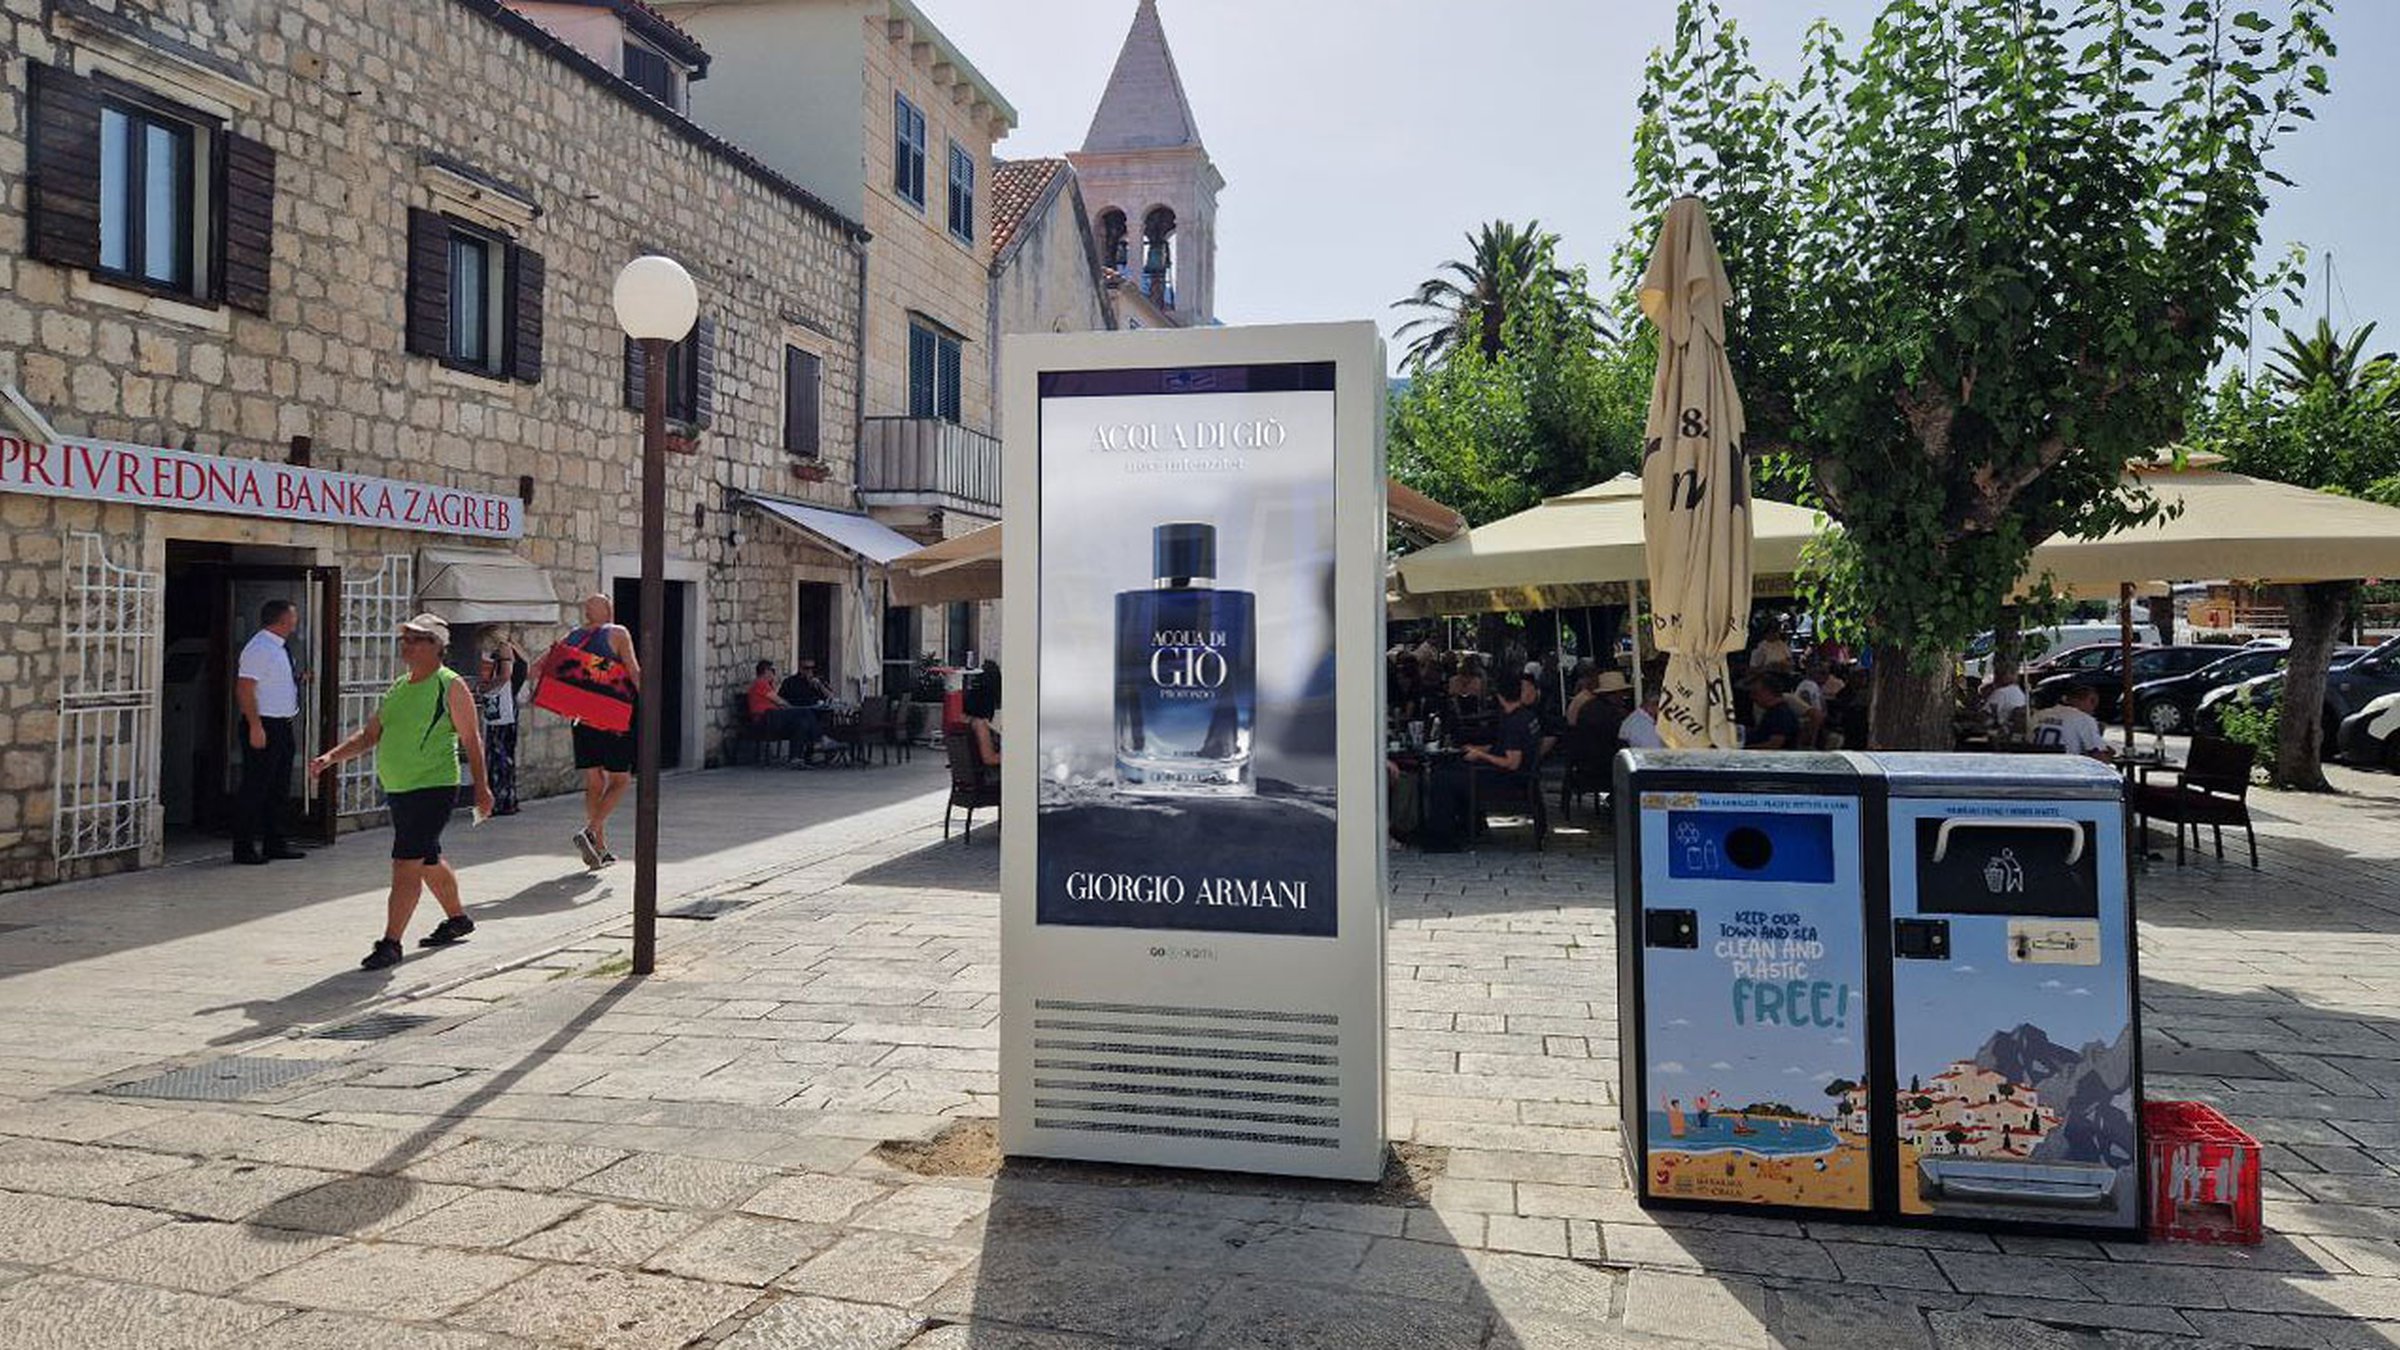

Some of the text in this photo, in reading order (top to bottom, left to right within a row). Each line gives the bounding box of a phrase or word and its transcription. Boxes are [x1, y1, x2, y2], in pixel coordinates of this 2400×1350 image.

[1094, 422, 1188, 451] ACQUA
[1195, 421, 1226, 449] DI
[0, 435, 510, 532] PRIVREDNA BANKA ZAGREB
[1151, 630, 1226, 647] ACQUA DI
[1066, 871, 1308, 909] GIORGIO ARMANI
[1735, 911, 1801, 926] KEEP OUR
[1720, 922, 1818, 941] TOWN AND SEA
[1714, 937, 1824, 959] CLEAN AND
[1732, 958, 1808, 980] PLASTIC
[1733, 977, 1849, 1029] FREE!
